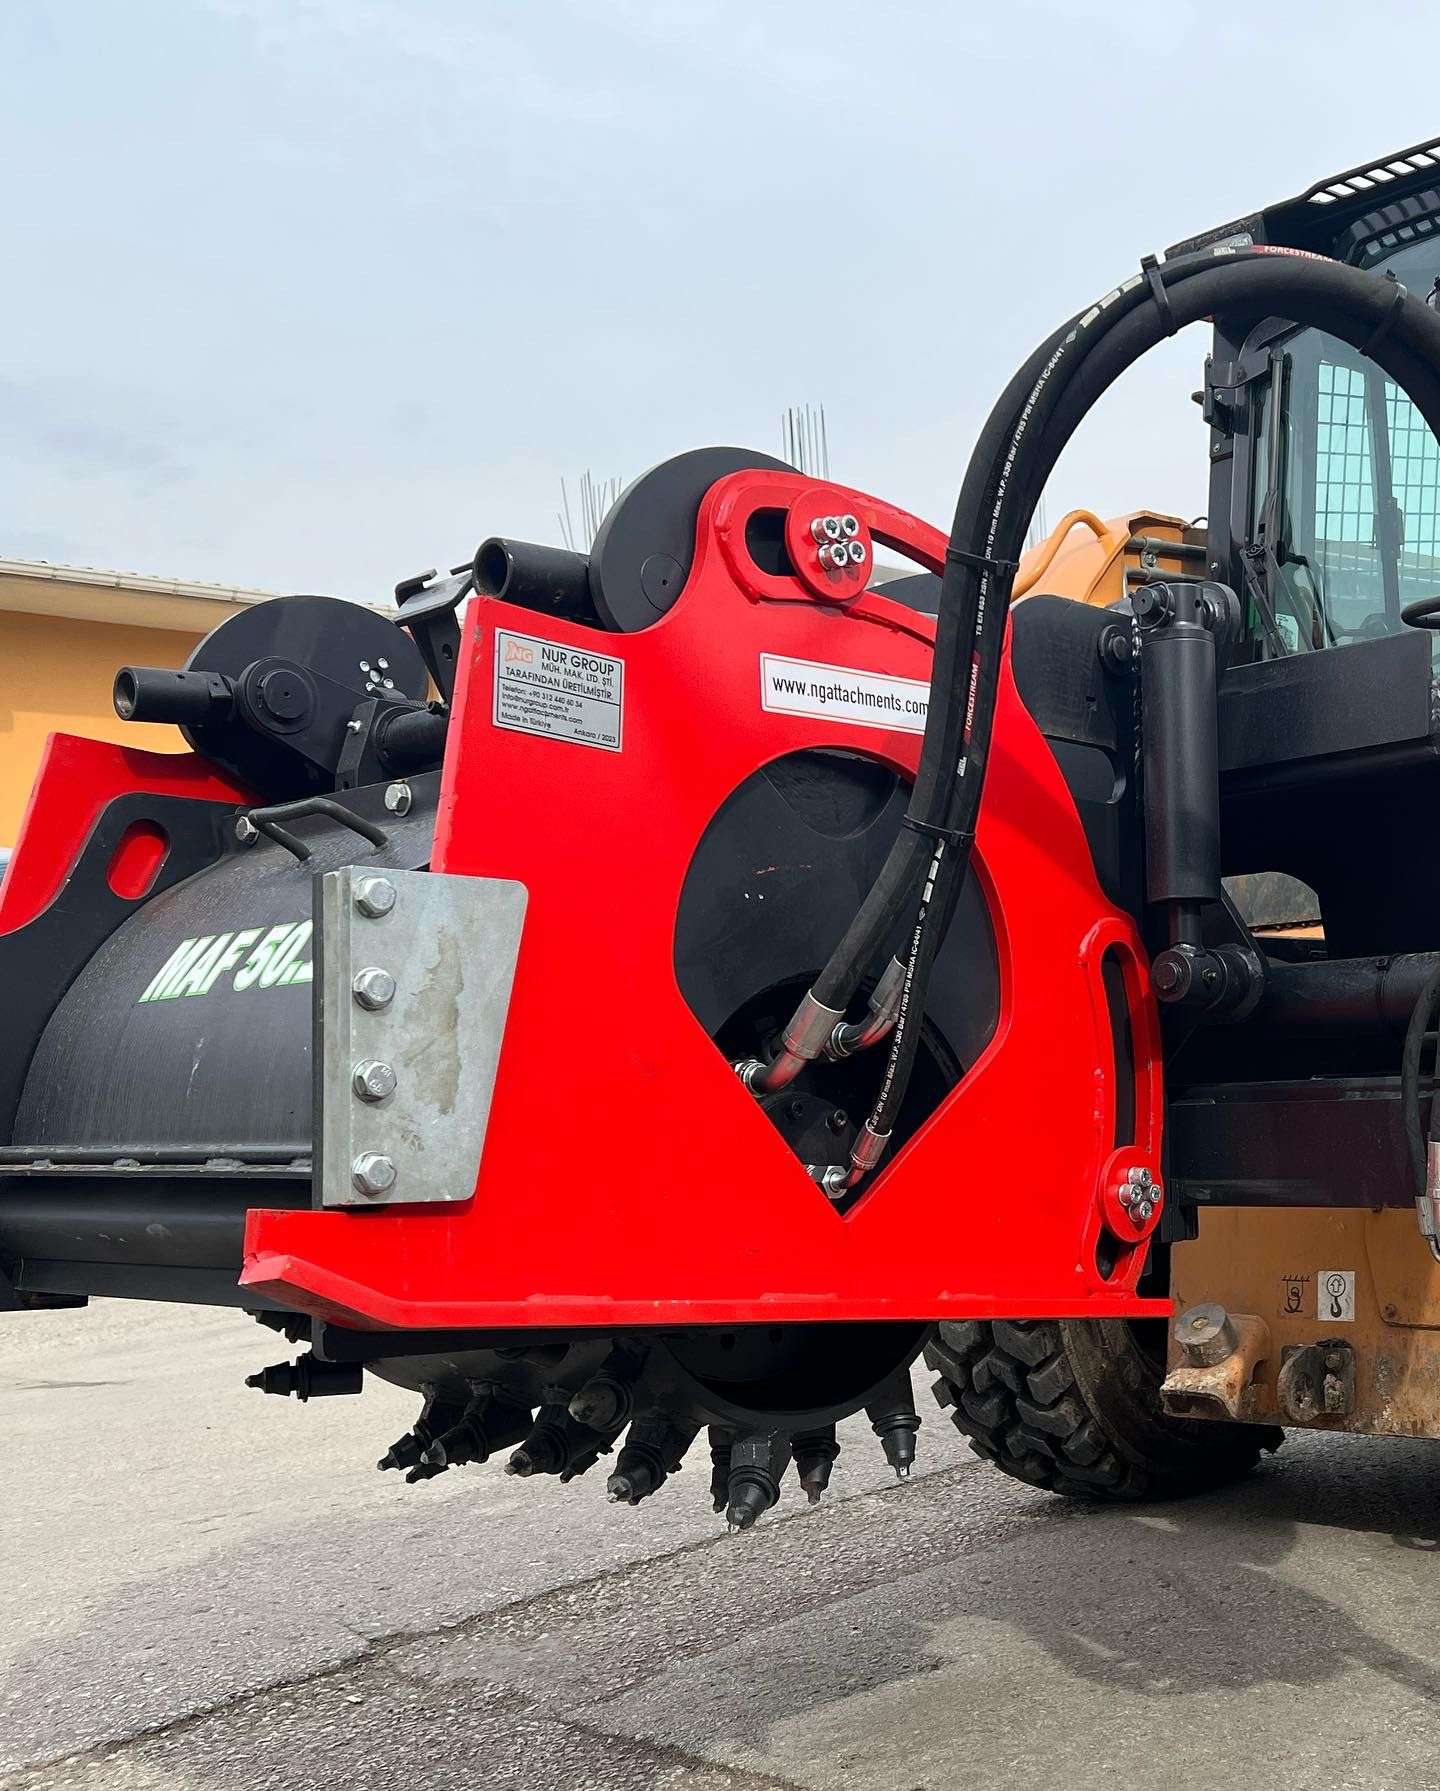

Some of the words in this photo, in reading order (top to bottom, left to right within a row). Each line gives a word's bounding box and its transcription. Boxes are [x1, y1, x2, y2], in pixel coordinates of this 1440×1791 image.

[1264, 245, 1334, 263] FORCESTREAM
[1029, 379, 1045, 405] MSHA
[1022, 404, 1033, 421] PSI
[1007, 447, 1017, 461] Bar
[997, 478, 1008, 497] W.P.
[992, 498, 1003, 518] Max.
[990, 518, 998, 535] mm
[987, 534, 995, 546] 10
[984, 546, 992, 560] DN
[541, 647, 567, 665] NUR
[570, 655, 615, 676] GROUP
[541, 661, 562, 675] MÜH.
[563, 667, 583, 680] MAK.
[586, 673, 600, 685] LTD.
[505, 666, 560, 689] TARAFINDAN
[562, 678, 615, 700] ÜRETİLMİŞTİR.
[501, 683, 527, 696] Telefon:
[528, 689, 541, 699] +90
[541, 692, 553, 702] 312
[554, 695, 566, 704] 440
[566, 698, 574, 707] 60
[772, 676, 929, 716] www.ngattachments.com
[965, 663, 979, 731] FORCESTREAM
[501, 711, 521, 723] Made
[522, 716, 529, 724] in
[573, 728, 597, 739] Ankara
[601, 734, 616, 744] 2023
[138, 926, 265, 1003] MAF
[906, 954, 917, 979] MSHA
[904, 979, 912, 993] PSI
[894, 1030, 903, 1044] 330
[887, 1062, 896, 1080] Max.
[884, 1079, 892, 1093] mm
